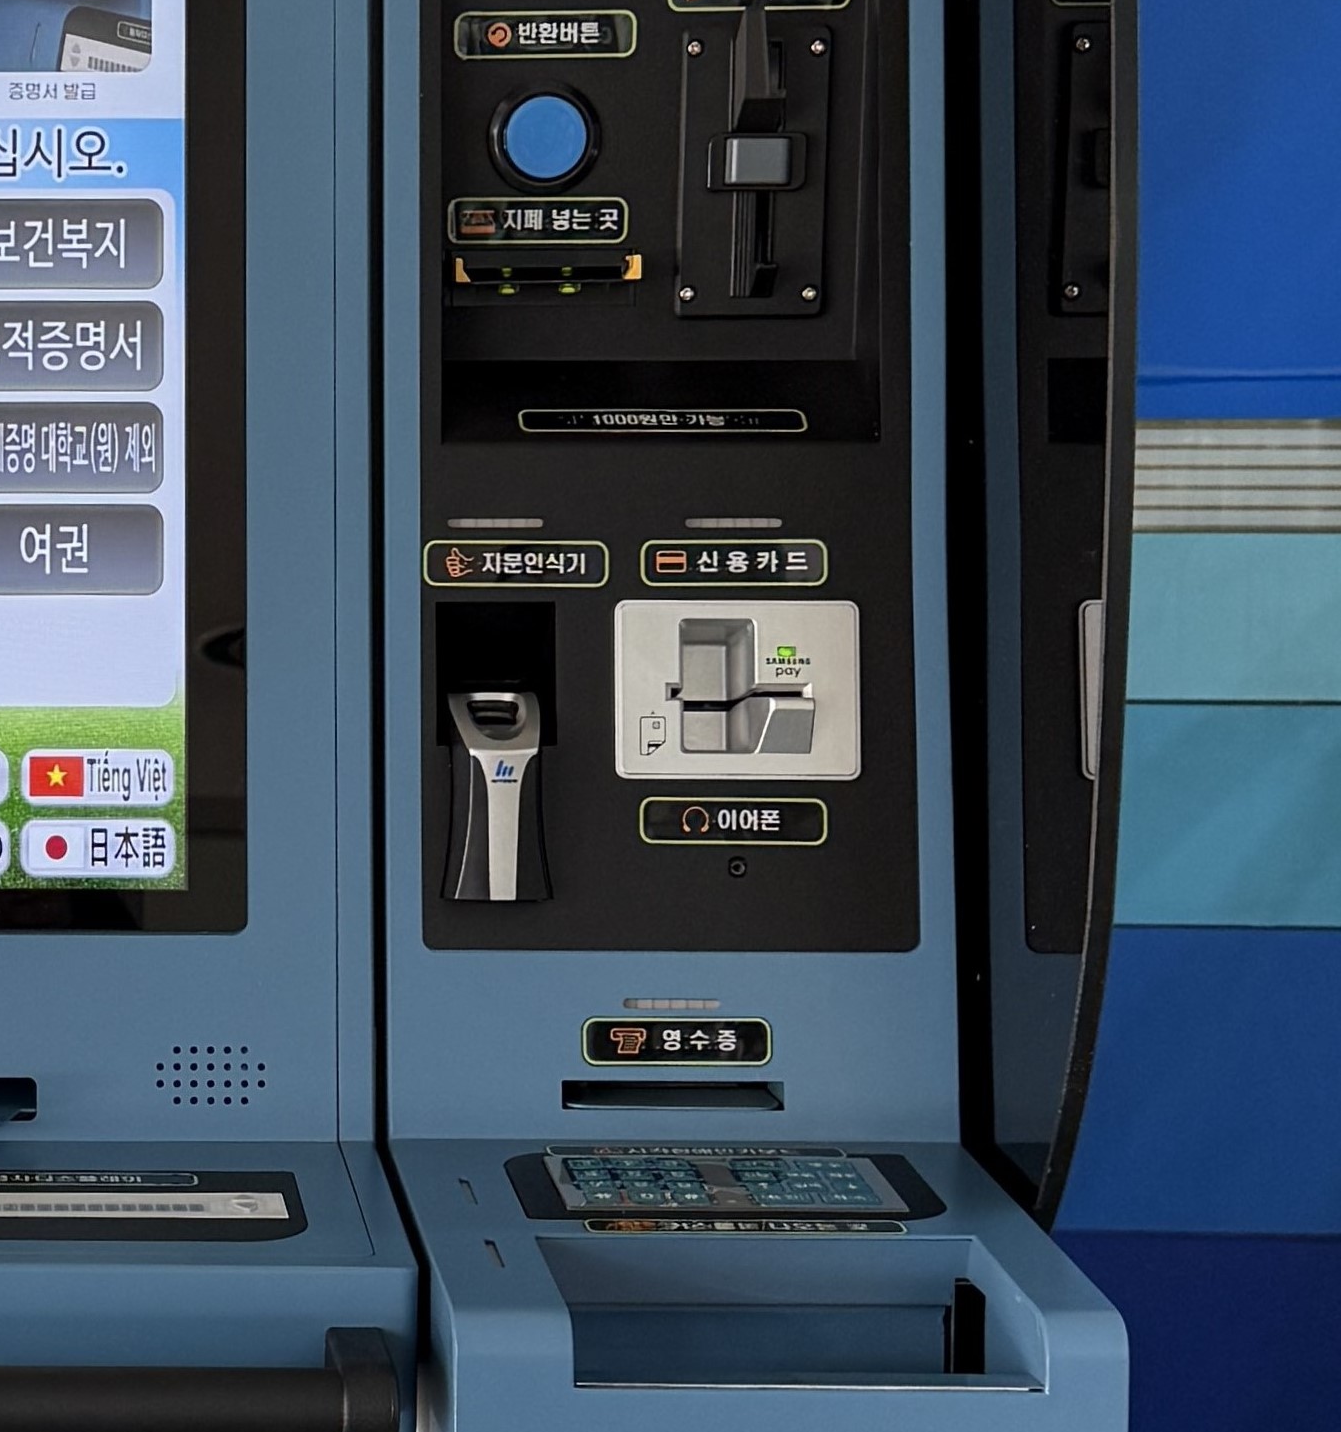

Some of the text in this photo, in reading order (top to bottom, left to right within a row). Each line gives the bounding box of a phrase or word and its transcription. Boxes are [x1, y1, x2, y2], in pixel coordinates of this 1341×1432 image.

[517, 21, 600, 45] 반환버튼
[9, 82, 96, 100] 증명서 발급
[502, 208, 619, 232] 지폐 넣는 곳
[41, 422, 119, 474] 대학교(원)
[125, 422, 156, 474] 제외
[20, 522, 89, 575] 여권
[481, 551, 587, 576] 지문인식기
[775, 667, 802, 678] pay
[87, 751, 167, 801] Tiếng Việt
[717, 809, 781, 832] 이어폰
[90, 826, 166, 868] 日本語
